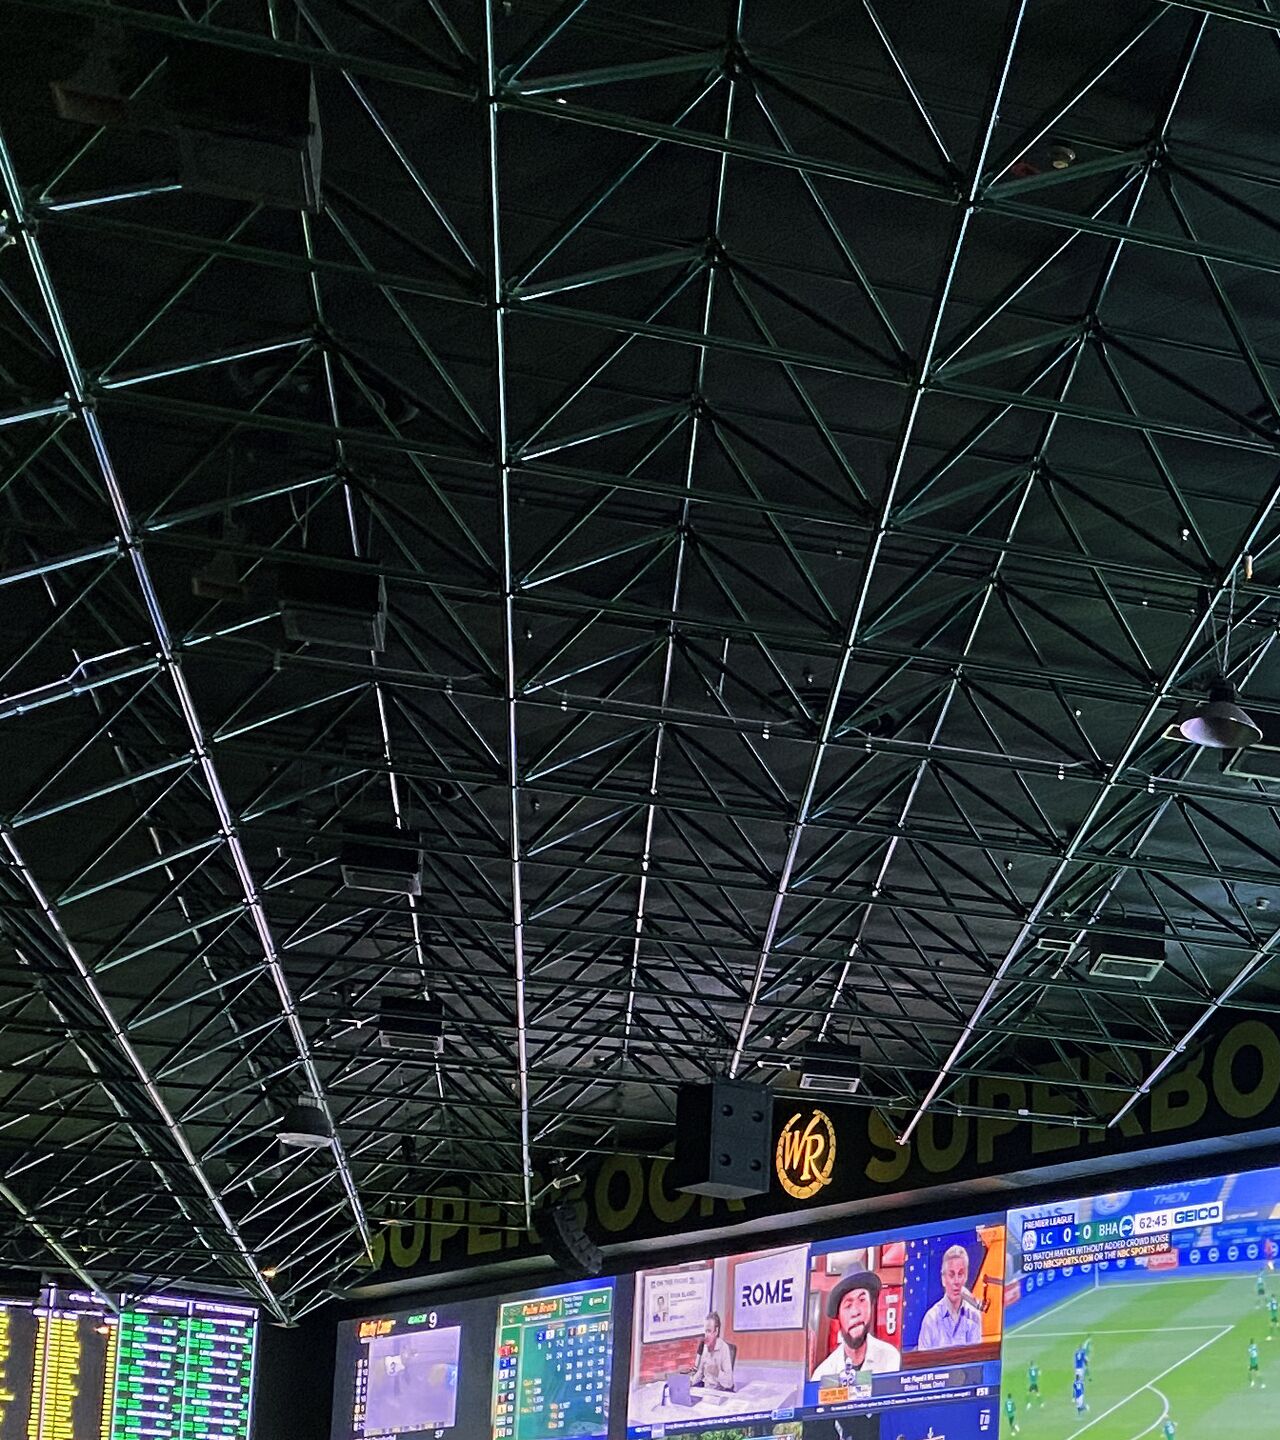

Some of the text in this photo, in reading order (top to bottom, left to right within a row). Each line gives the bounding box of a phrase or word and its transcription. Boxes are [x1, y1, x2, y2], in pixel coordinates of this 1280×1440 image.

[1024, 1215, 1073, 1230] PREMIER LEAGUE
[1174, 1206, 1219, 1224] GEICO
[1041, 1215, 1167, 1245] LC 0 0 BHA 62:45
[742, 1278, 793, 1307] ROME
[429, 1312, 437, 1328] 9
